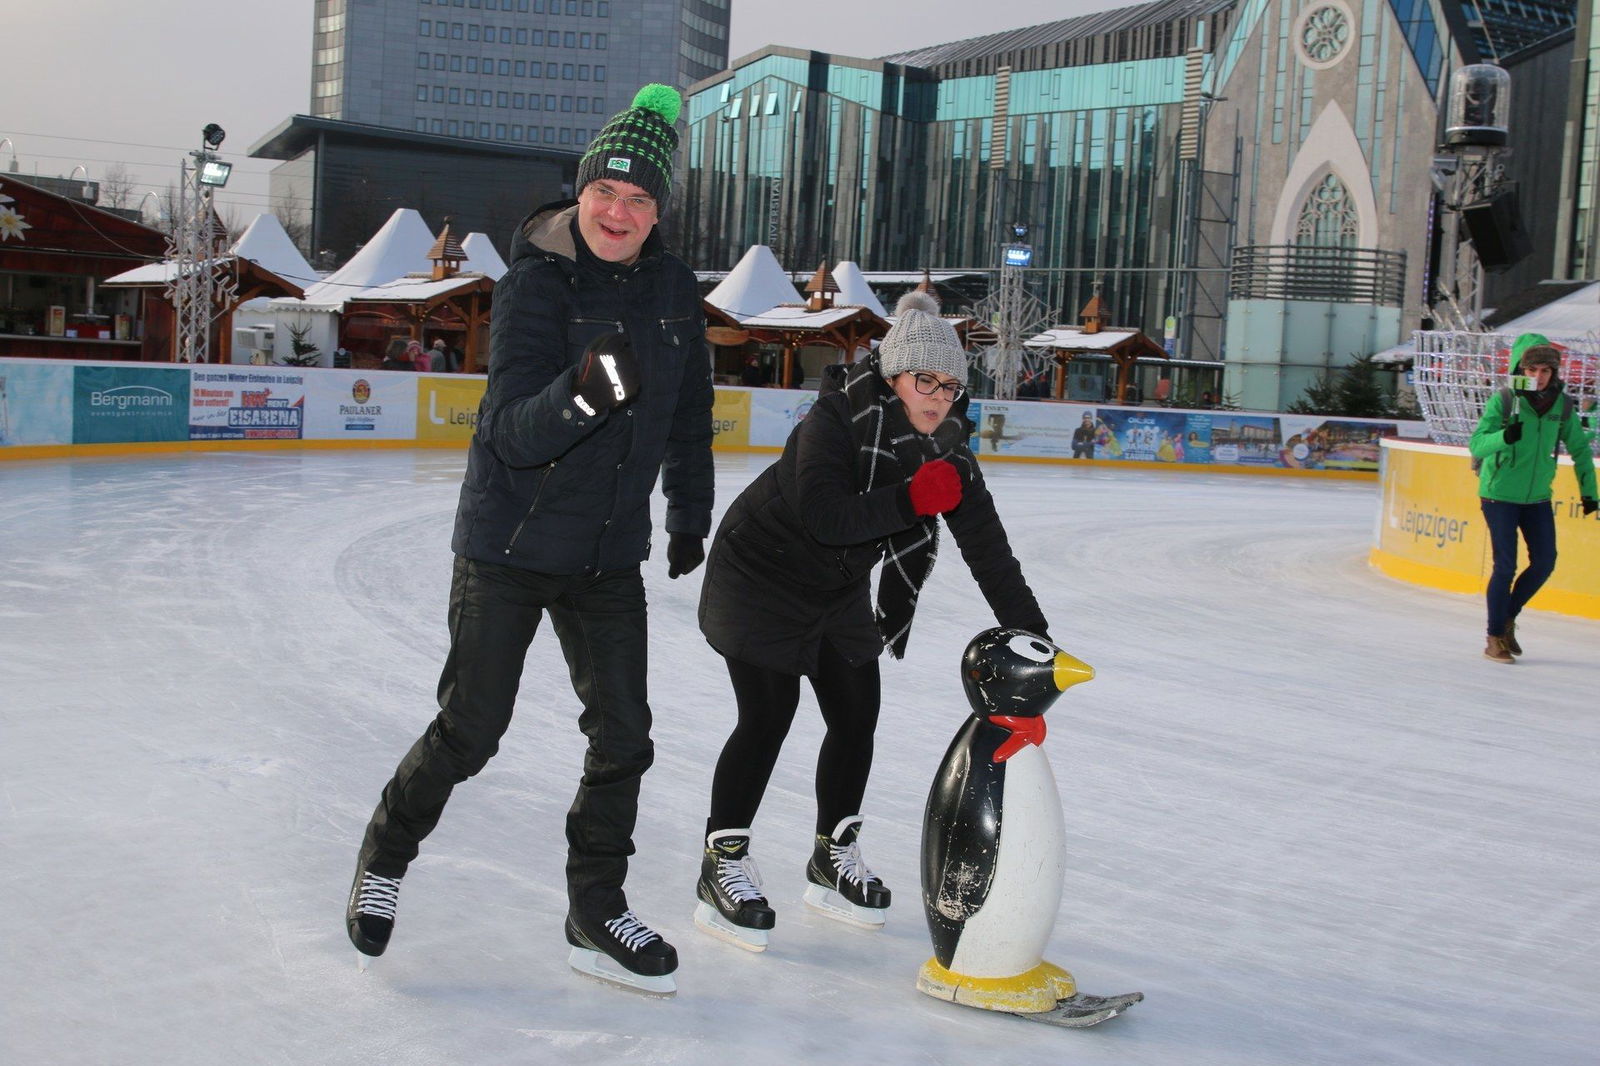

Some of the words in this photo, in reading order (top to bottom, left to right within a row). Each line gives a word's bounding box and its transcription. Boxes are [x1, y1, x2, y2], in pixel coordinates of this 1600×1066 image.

[91, 391, 173, 409] Bergmann
[229, 409, 299, 426] EISARENA
[339, 405, 382, 415] PAULANER
[1401, 501, 1468, 548] Leipziger
